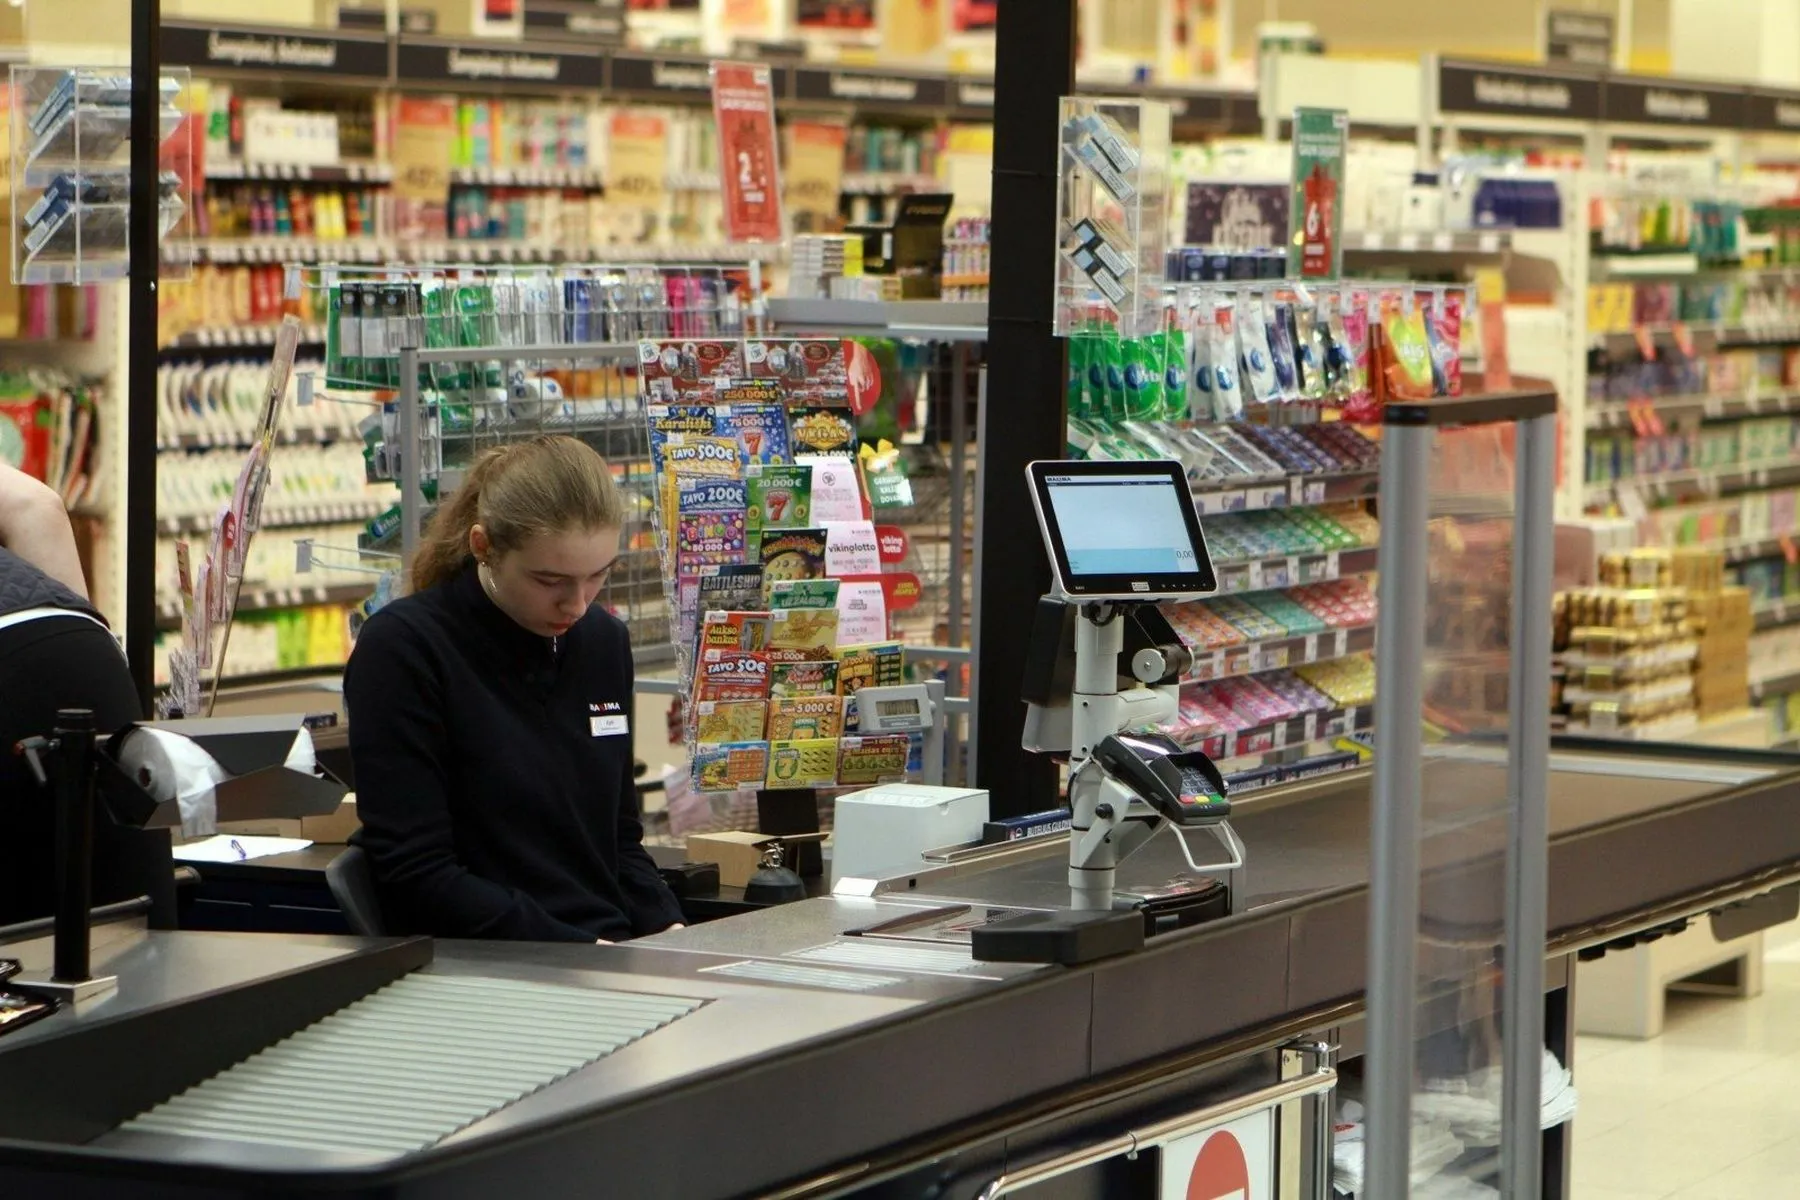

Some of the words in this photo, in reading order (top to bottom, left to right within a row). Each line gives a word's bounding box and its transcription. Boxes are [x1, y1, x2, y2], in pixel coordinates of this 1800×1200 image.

[773, 479, 794, 487] 000
[707, 487, 743, 502] 200€
[827, 542, 877, 555] vikinglotto
[1176, 550, 1193, 560] 0,00
[703, 575, 761, 591] BATTLESHIP
[710, 625, 738, 635] Aukso
[706, 634, 738, 645] bankas
[804, 702, 824, 713] 000
